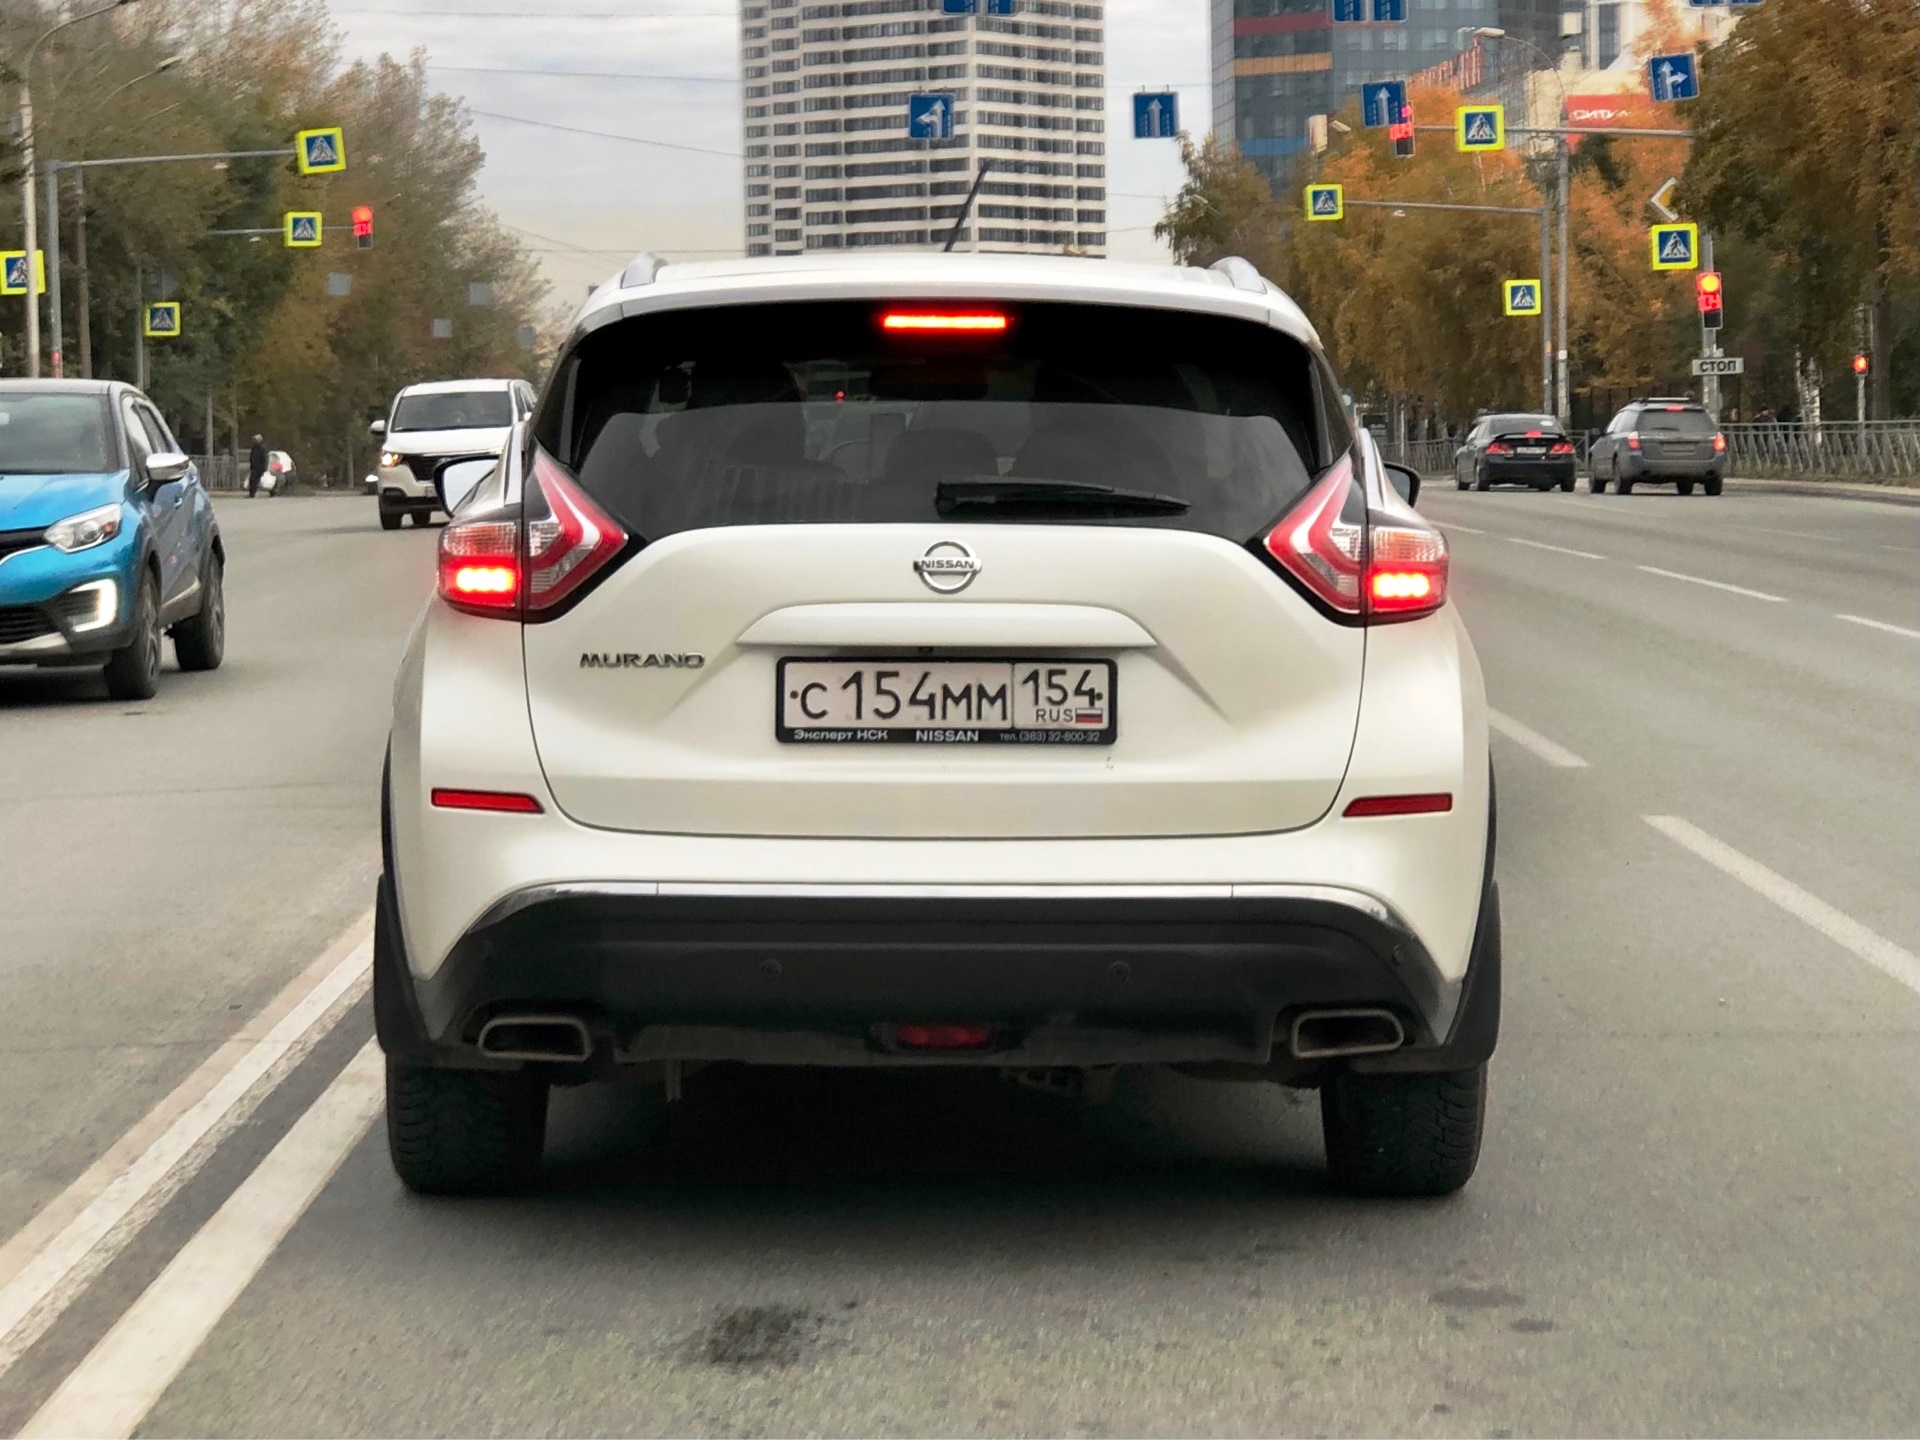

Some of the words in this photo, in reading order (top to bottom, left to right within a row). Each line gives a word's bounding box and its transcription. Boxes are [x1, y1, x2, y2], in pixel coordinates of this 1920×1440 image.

[1700, 360, 1736, 373] СТОП
[921, 560, 974, 569] NISSAN
[580, 653, 705, 668] MURANO
[1021, 668, 1097, 708] 154
[1035, 708, 1074, 723] RUS
[794, 729, 853, 742] Эксперт
[856, 729, 888, 741] НСК
[915, 729, 980, 743] NISSAN
